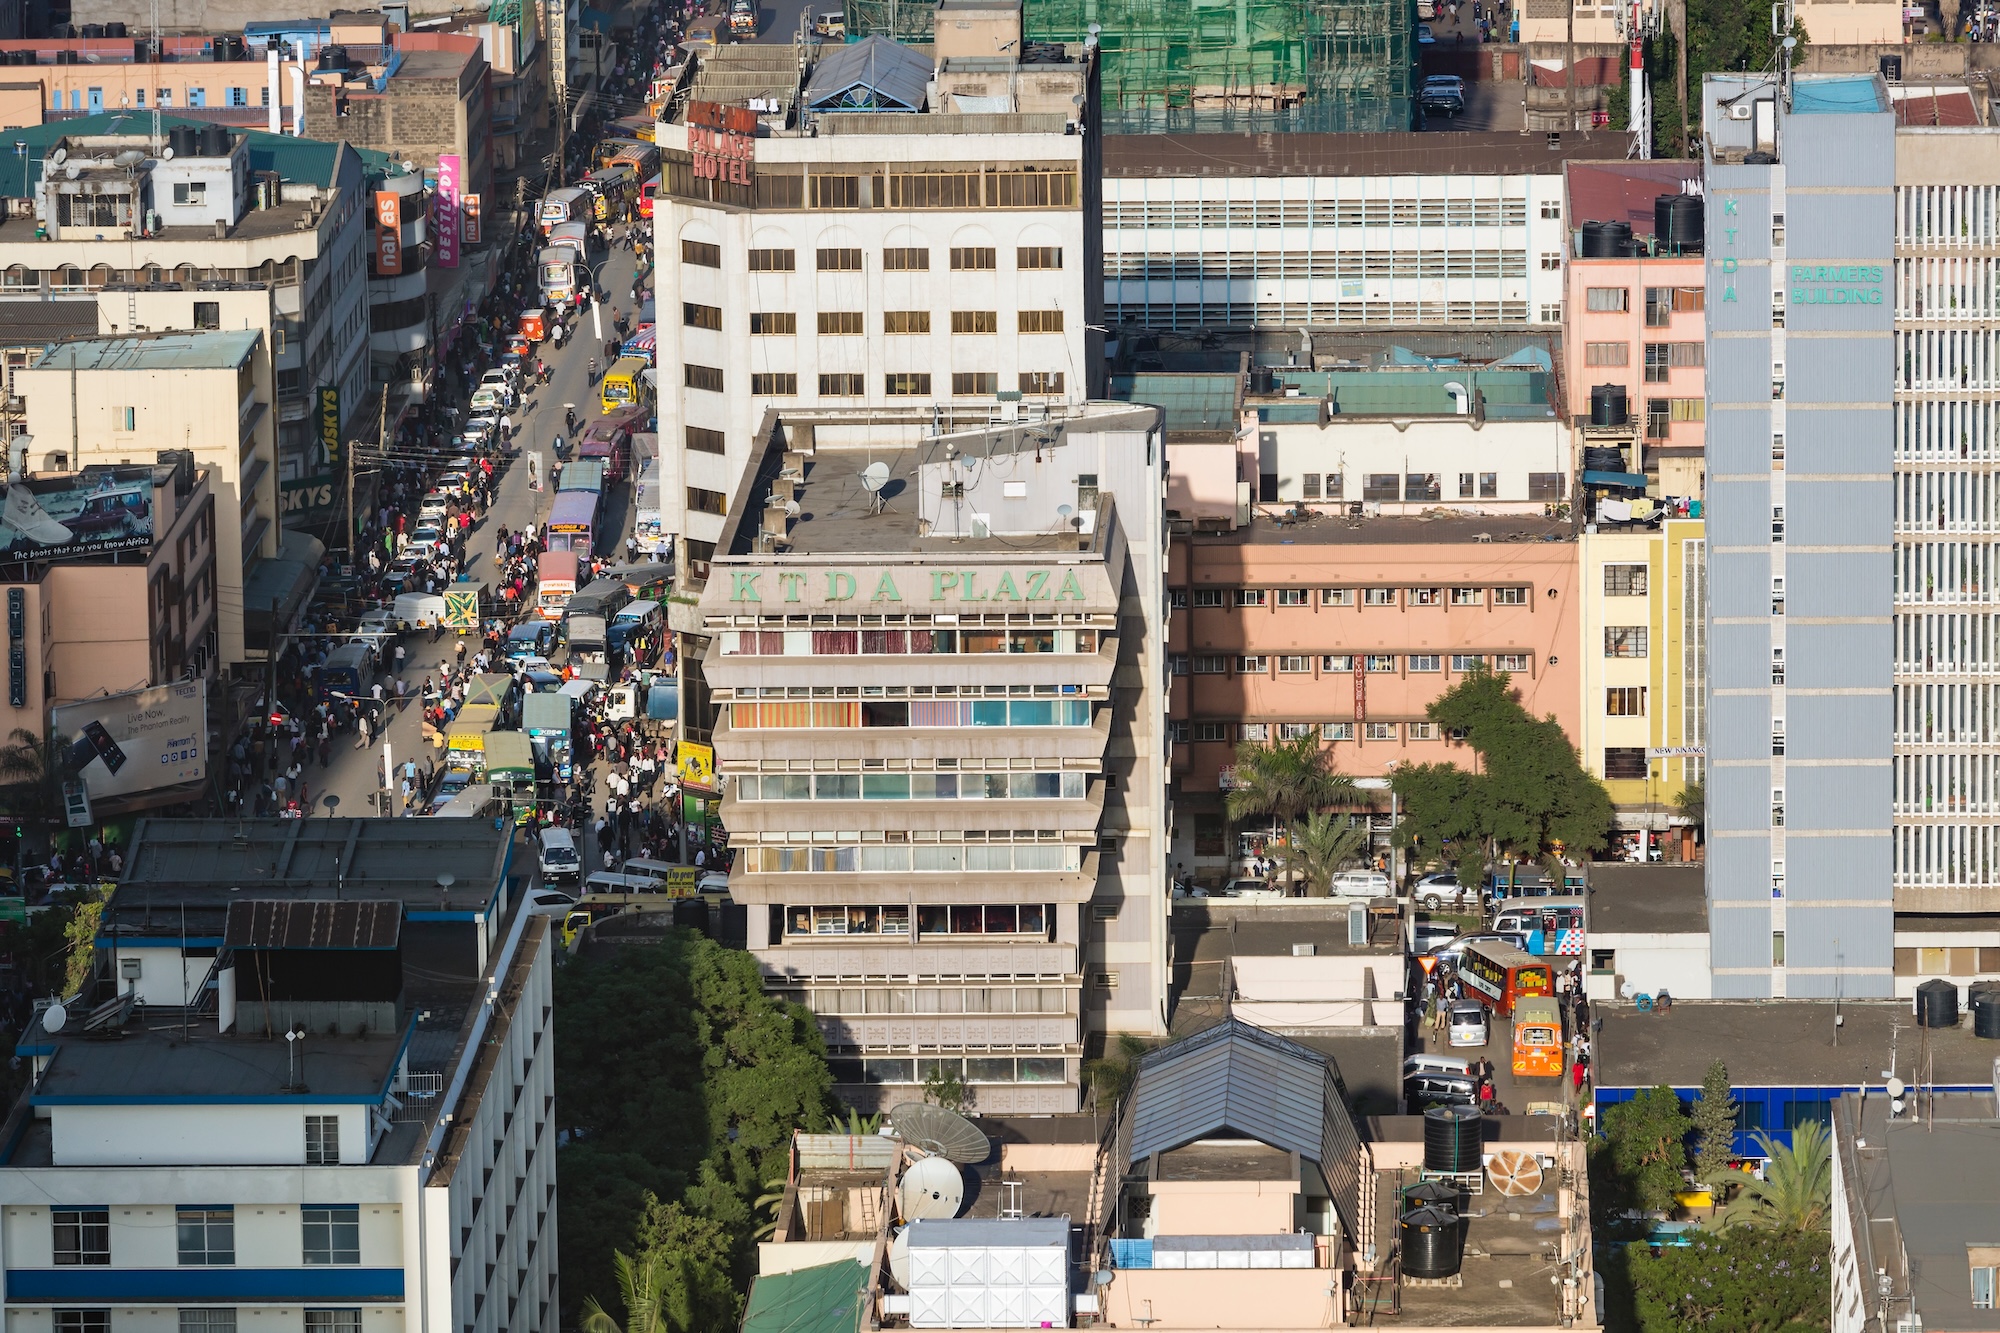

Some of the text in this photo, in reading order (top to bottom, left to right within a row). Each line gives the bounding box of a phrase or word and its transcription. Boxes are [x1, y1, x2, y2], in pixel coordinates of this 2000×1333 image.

[688, 127, 755, 161] PALACE
[693, 152, 752, 186] HOTEL
[440, 161, 452, 261] BESTLADY
[380, 199, 396, 267] naivas
[1791, 265, 1884, 283] FARMERS
[1791, 287, 1883, 305] BUILDING
[320, 389, 339, 464] TUSKYS
[13, 537, 149, 560] The boots that say you know Africa
[929, 570, 1086, 602] PLAZA
[175, 686, 196, 696] TECNO
[127, 709, 166, 724] Live Now,
[128, 715, 190, 735] The Phantom Reality
[190, 732, 197, 747] 5
[668, 868, 694, 881] Top gear
